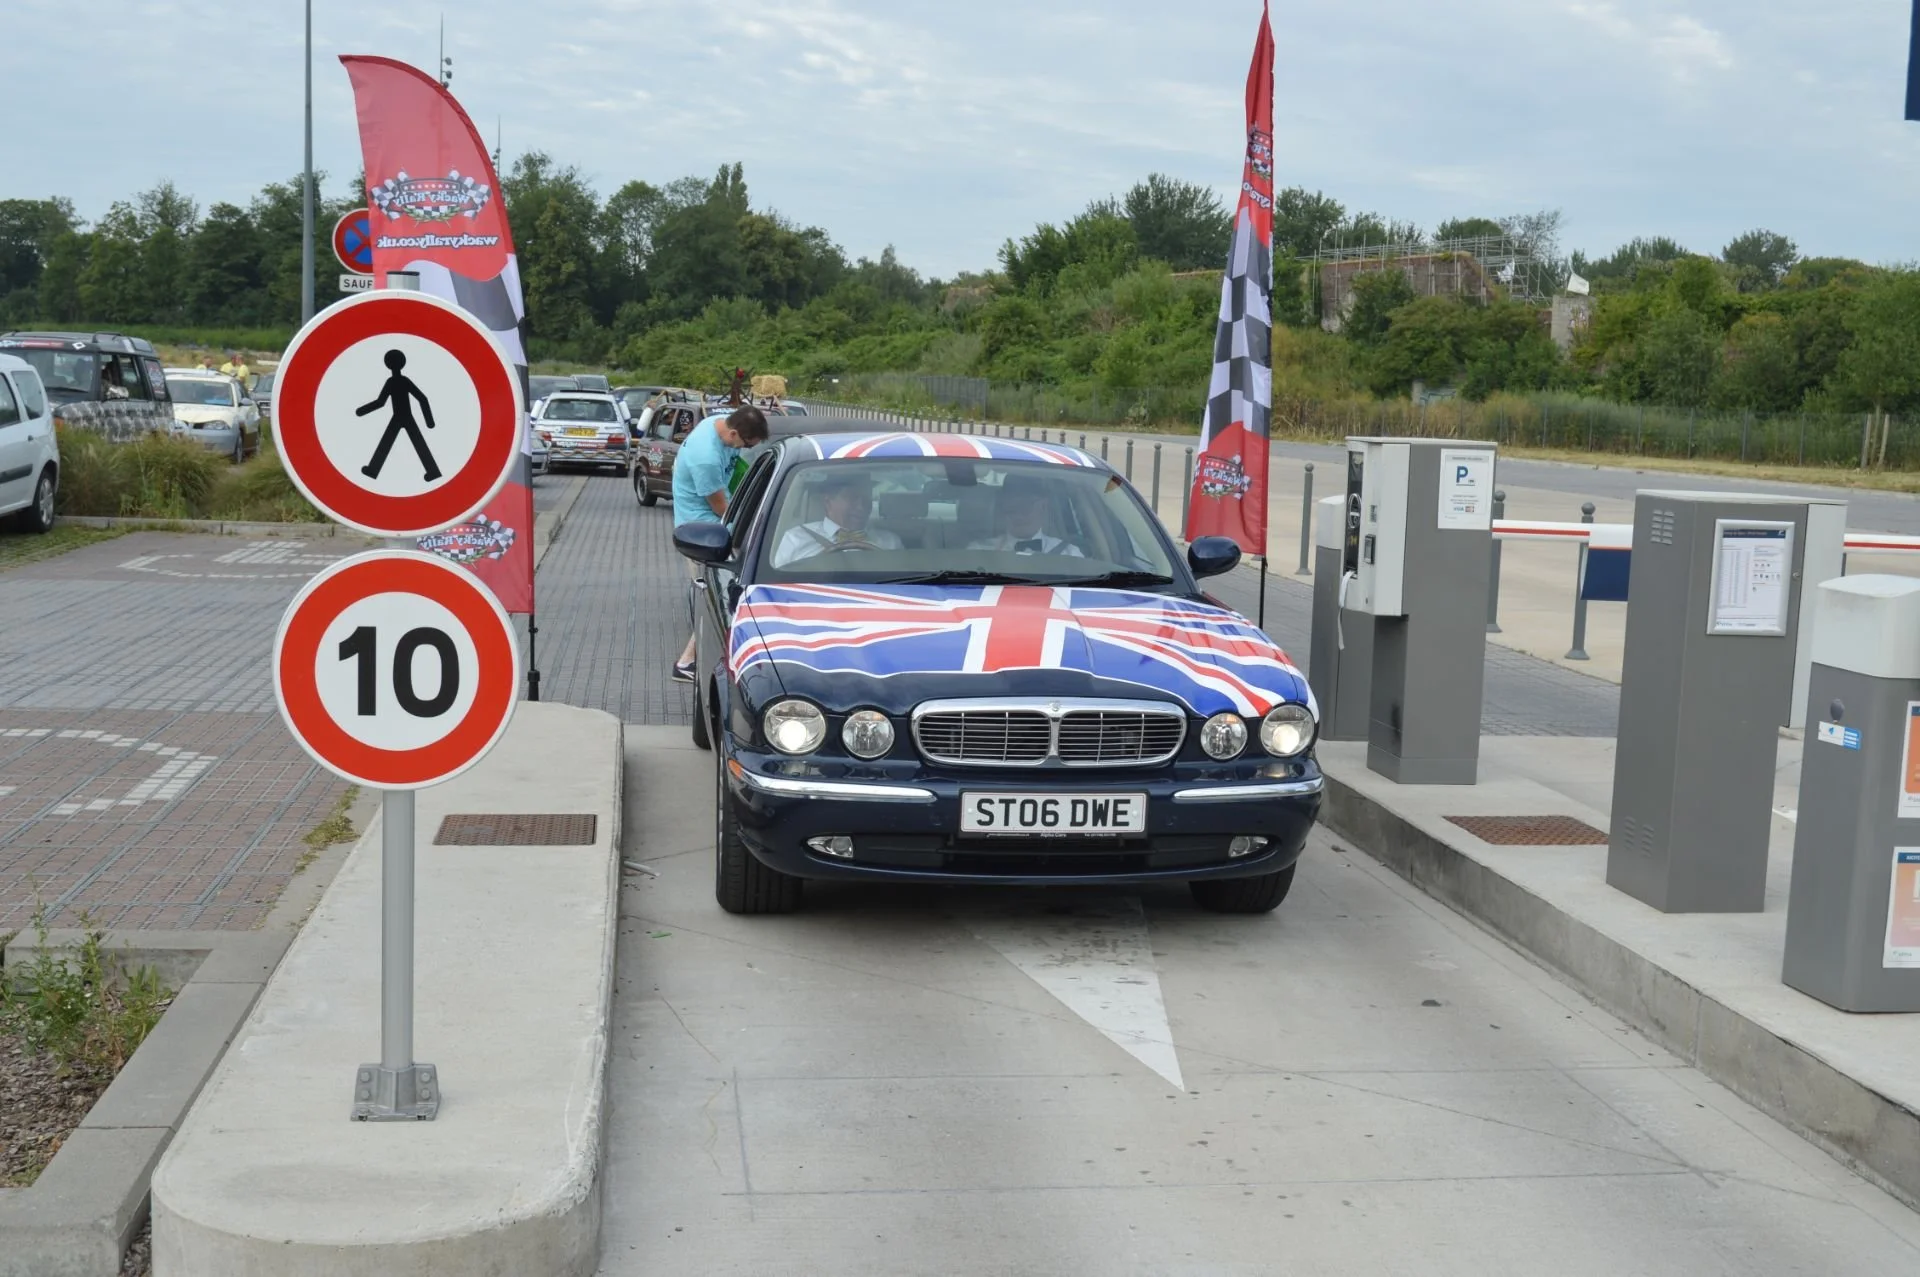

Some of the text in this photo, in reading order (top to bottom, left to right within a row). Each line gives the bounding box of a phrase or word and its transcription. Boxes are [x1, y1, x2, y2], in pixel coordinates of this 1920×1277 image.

[343, 278, 374, 289] SAUF
[338, 626, 460, 718] 10
[976, 798, 1131, 827] ST06 DWE
